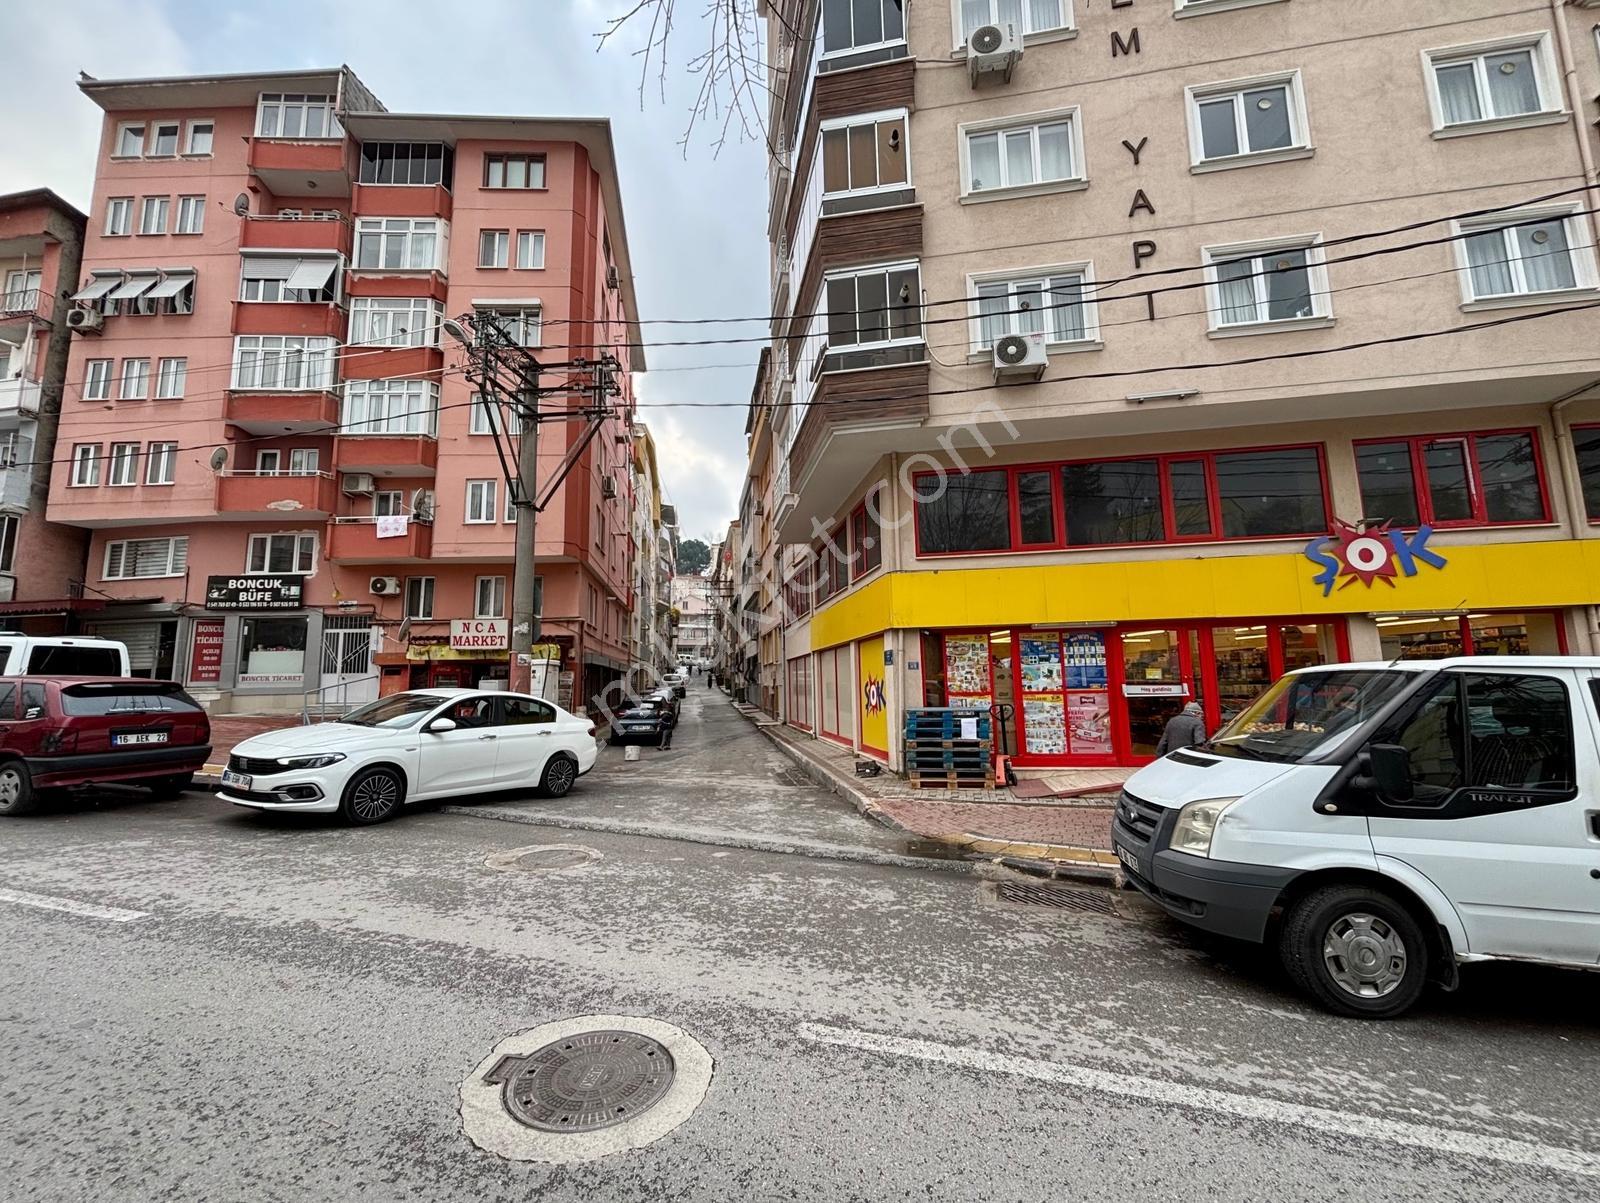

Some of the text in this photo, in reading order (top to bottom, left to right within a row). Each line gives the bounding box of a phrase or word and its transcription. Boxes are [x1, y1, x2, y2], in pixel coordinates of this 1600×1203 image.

[1122, 136, 1157, 321] YAPI
[1304, 523, 1447, 597] ŞOK
[228, 579, 283, 589] BONCUK
[239, 589, 273, 601] BÜFE
[197, 625, 225, 633] BONCU
[196, 635, 225, 644] TİCARE
[453, 636, 506, 646] MARKET
[157, 734, 166, 742] 22
[1470, 793, 1535, 803] TRANSIT
